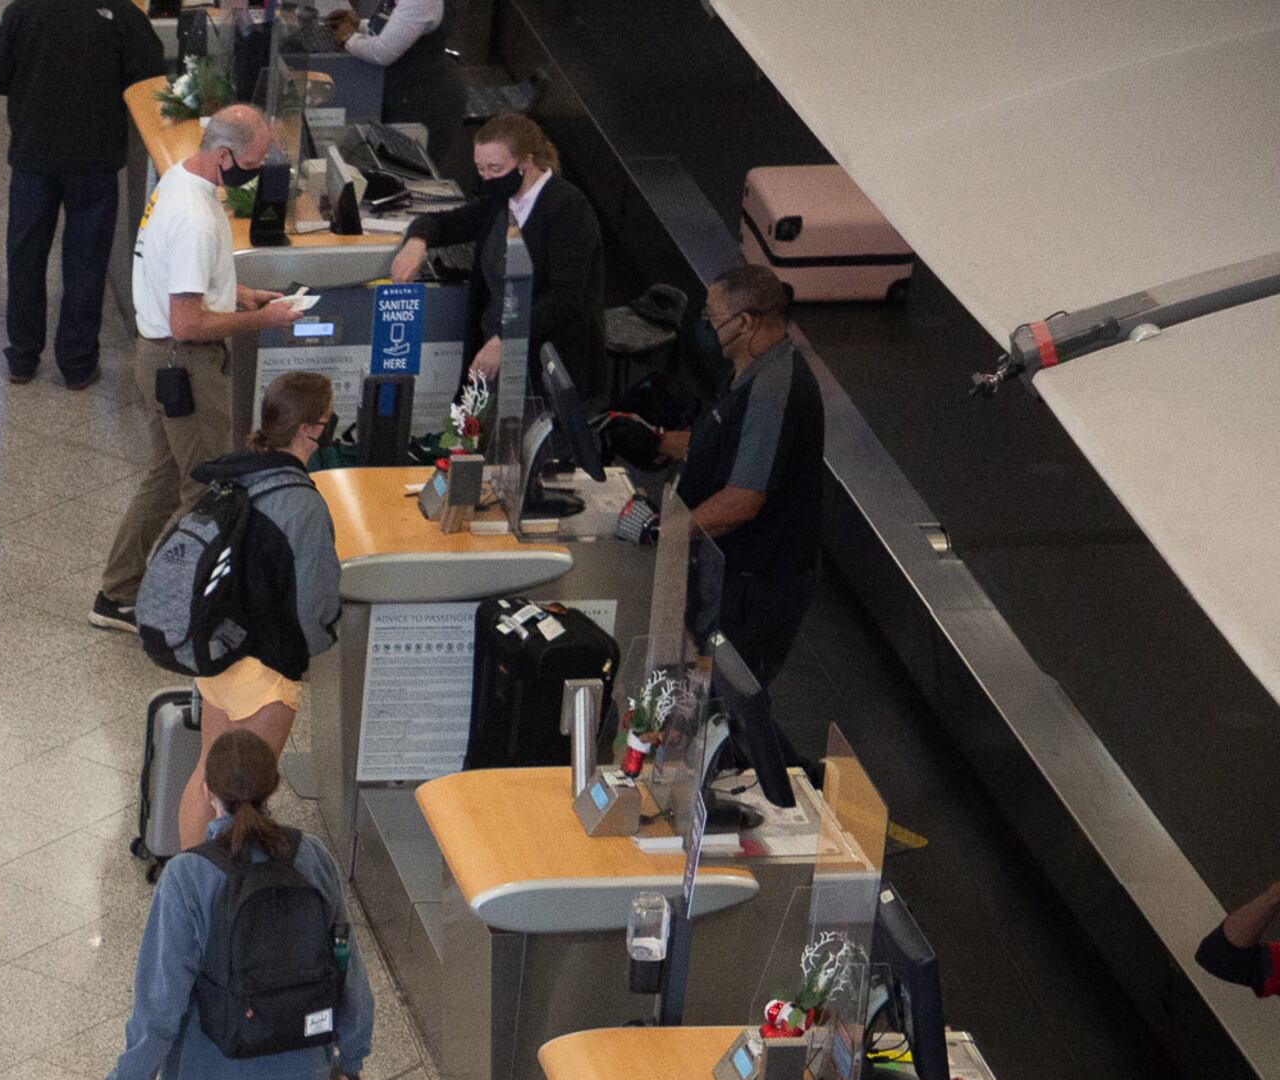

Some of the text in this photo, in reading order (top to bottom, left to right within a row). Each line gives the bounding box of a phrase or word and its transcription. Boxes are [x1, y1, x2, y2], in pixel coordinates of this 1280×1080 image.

[378, 299, 420, 311] SANITIZE
[382, 310, 415, 322] HANDS
[383, 358, 407, 369] HERE
[376, 614, 408, 624] ADVICE
[411, 614, 423, 623] TO
